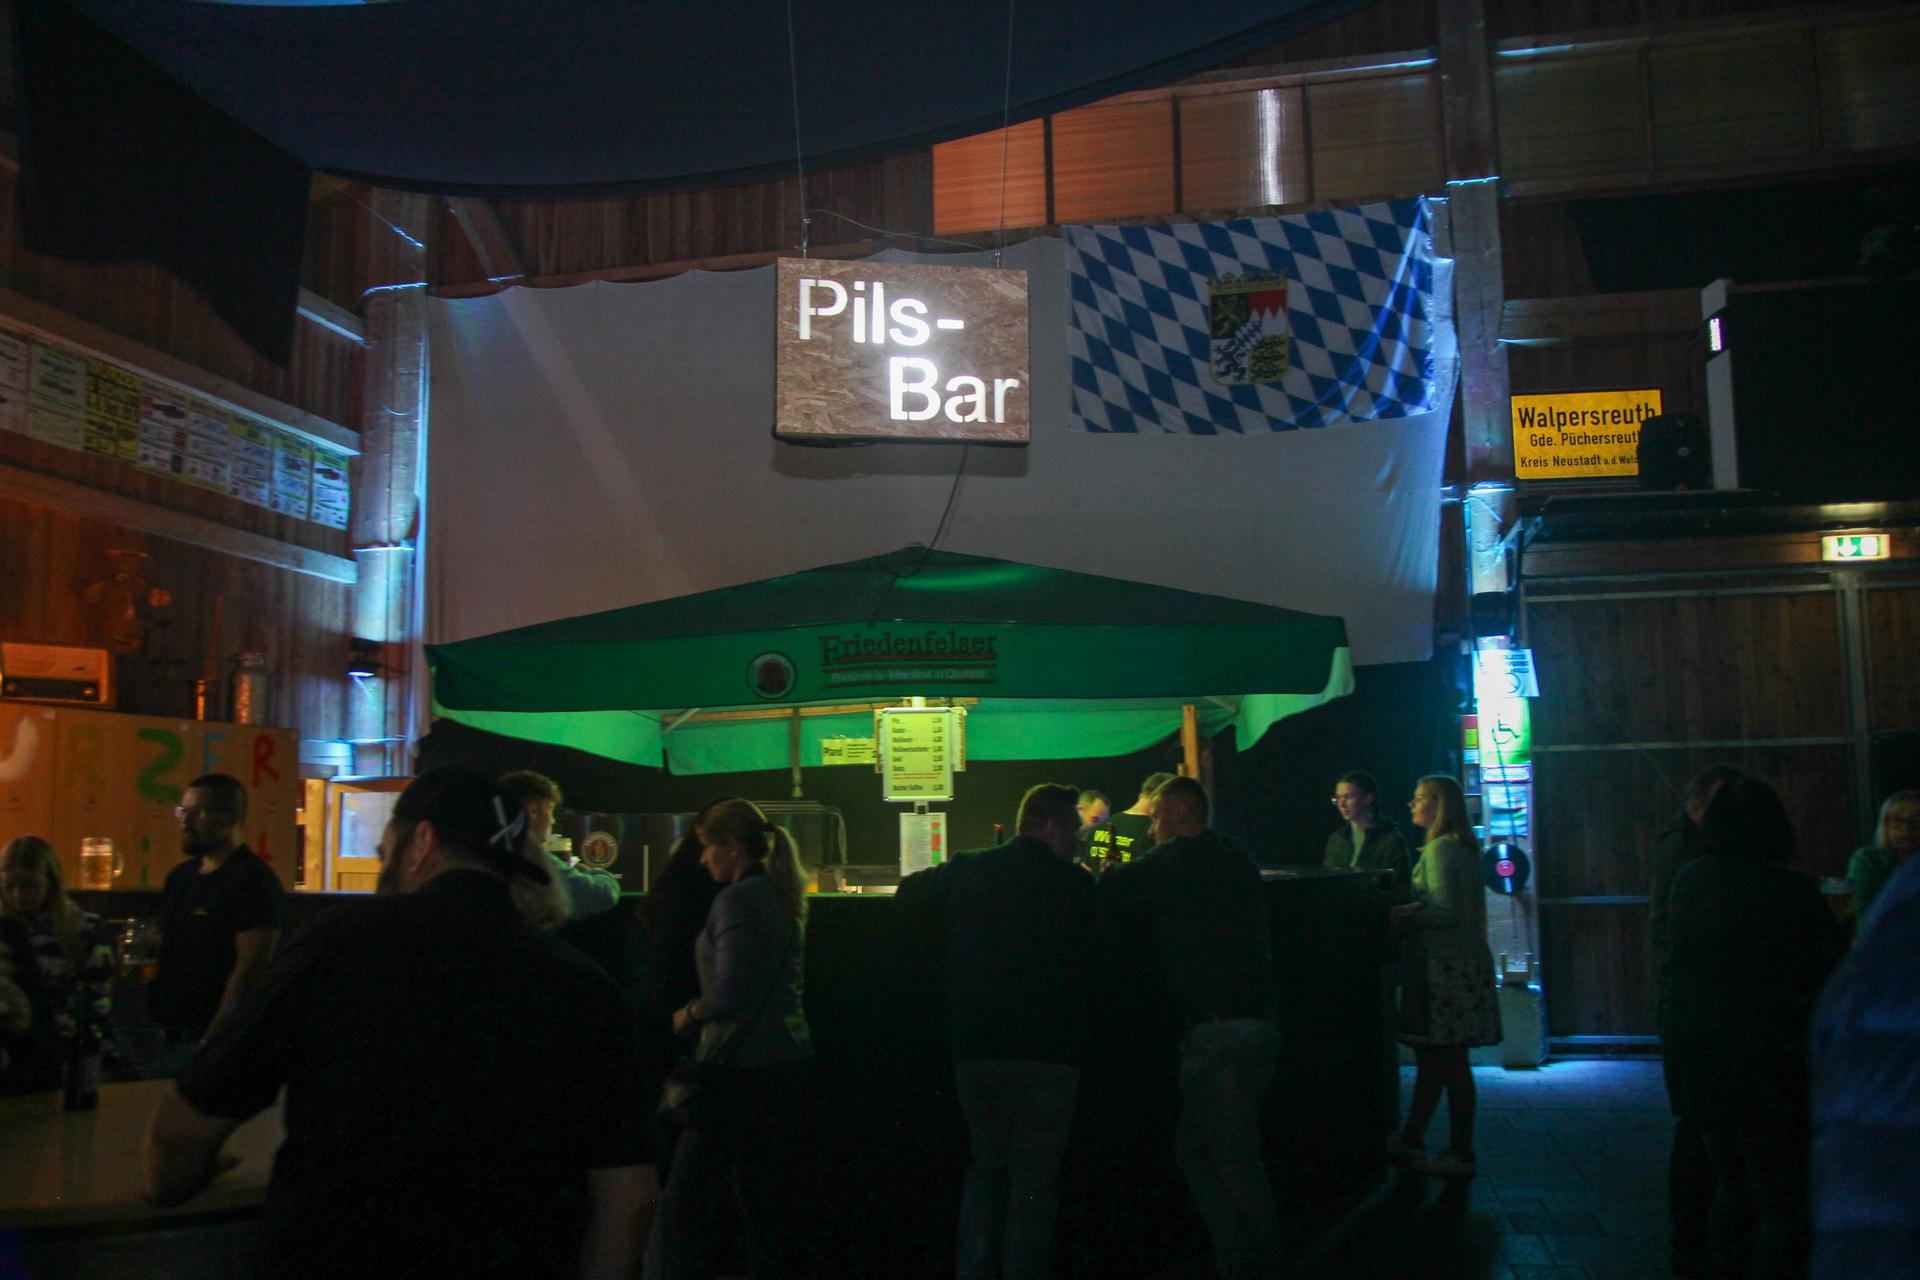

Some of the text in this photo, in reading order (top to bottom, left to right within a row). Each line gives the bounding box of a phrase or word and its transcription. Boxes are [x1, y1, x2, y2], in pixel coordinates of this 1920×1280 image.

[799, 278, 965, 346] Pils-
[889, 356, 1020, 424] Bar
[1517, 402, 1656, 433] Walpersreuth
[1530, 433, 1558, 447] Gde.
[1520, 455, 1549, 468] Kreis
[1552, 454, 1602, 467] Neustadt
[817, 630, 997, 666] Friedenfelser
